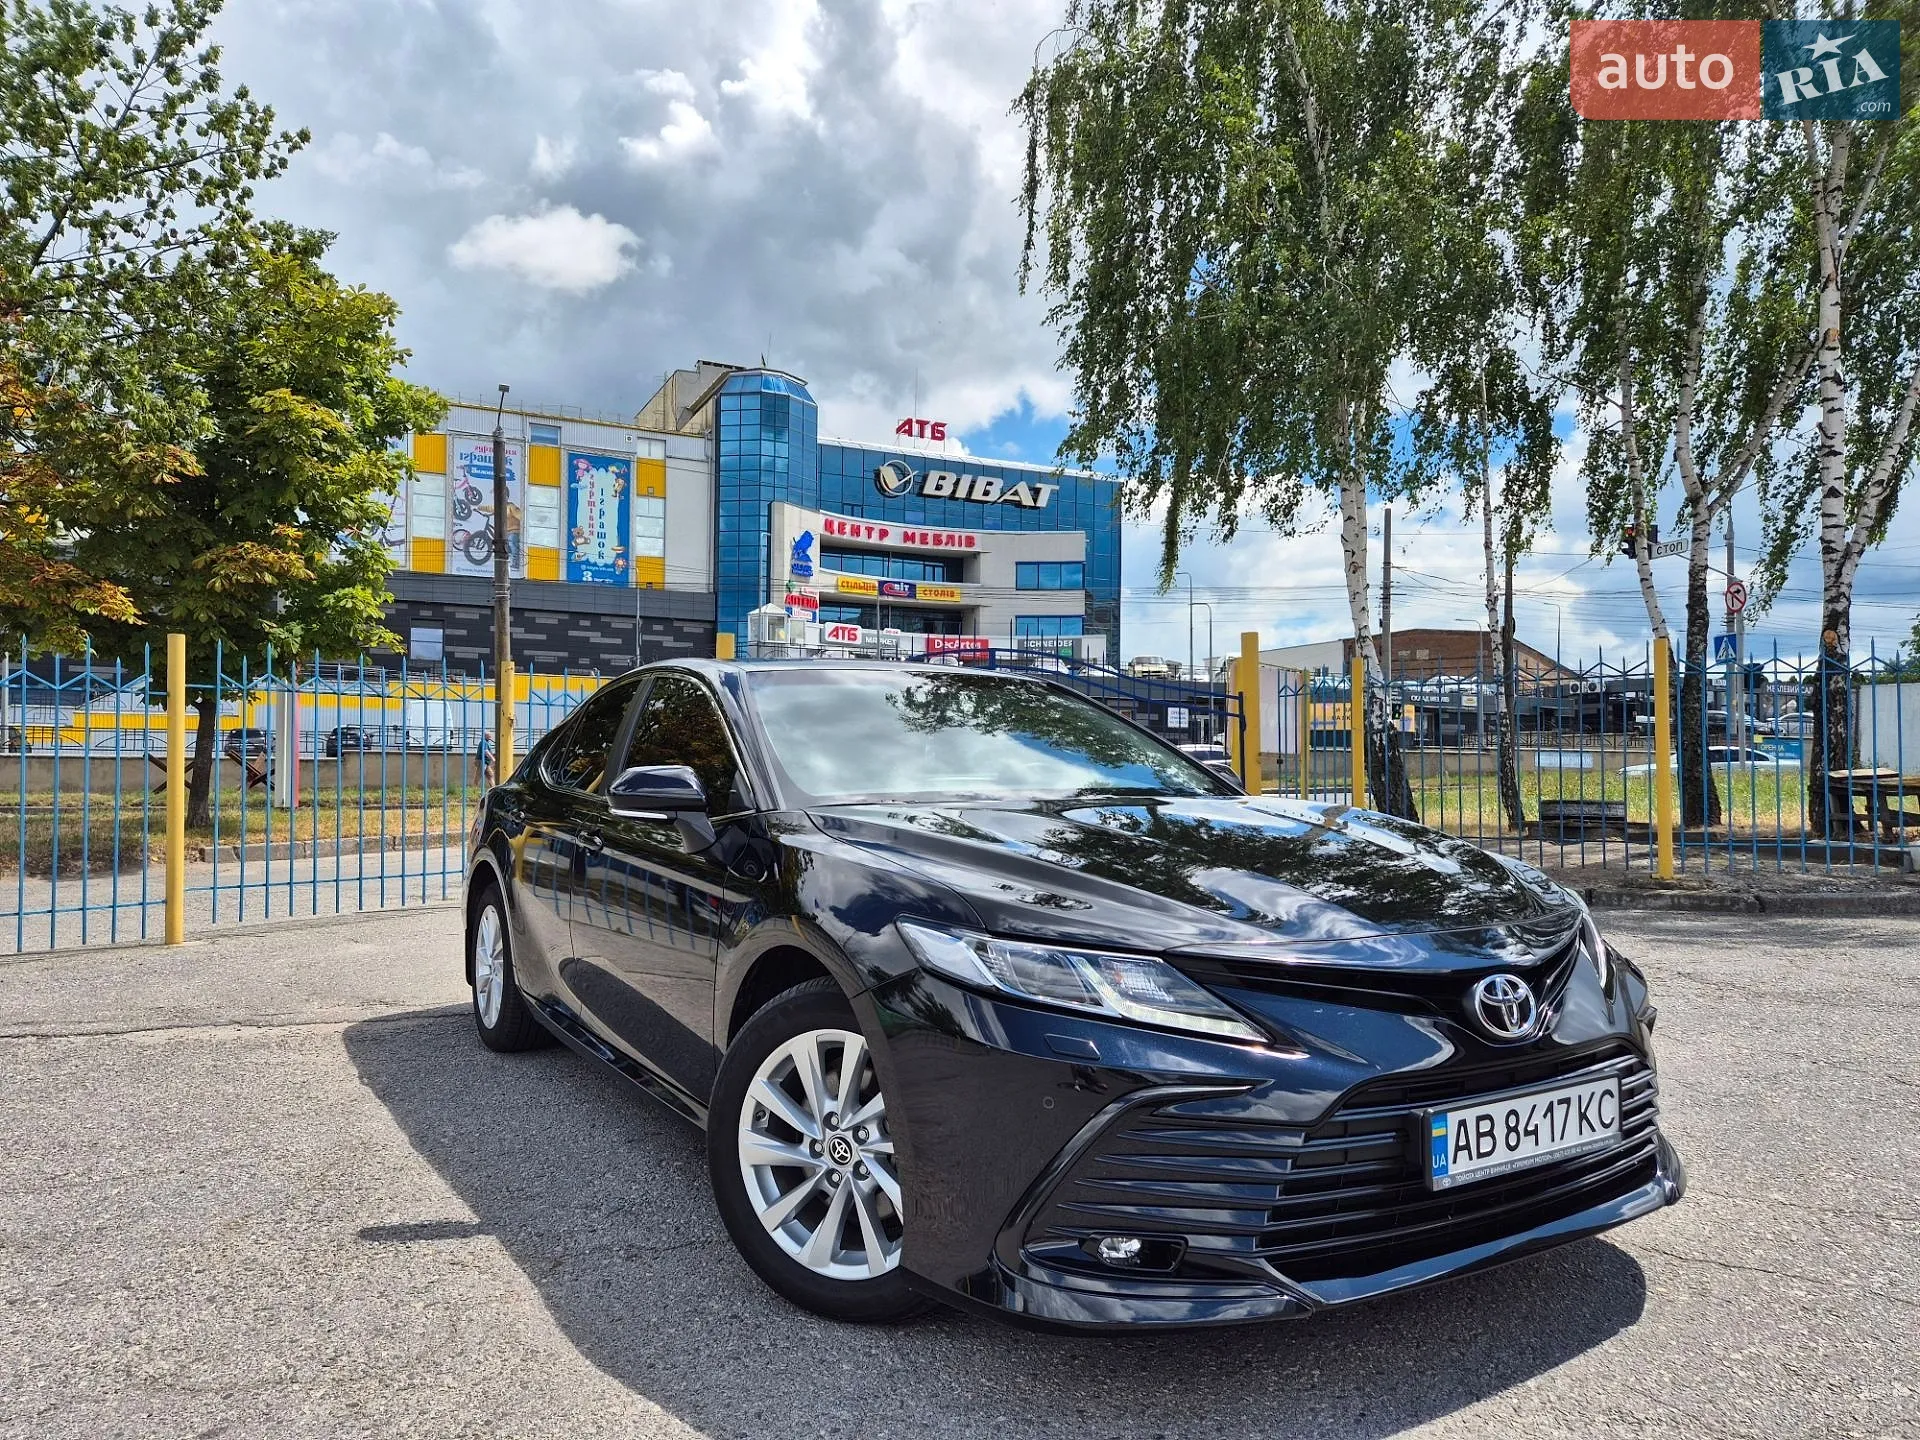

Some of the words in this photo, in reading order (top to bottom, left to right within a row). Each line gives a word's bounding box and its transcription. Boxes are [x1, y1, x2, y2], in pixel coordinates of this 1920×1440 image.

[896, 418, 948, 442] АТБ
[922, 470, 1060, 508] ВІВАТ
[824, 518, 890, 542] ЦЕНТР
[903, 530, 976, 549] МЕБЛІВ
[1656, 541, 1683, 555] СТОП
[922, 588, 956, 599] СТОЛІВ
[828, 625, 859, 642] АТБ
[1452, 1113, 1497, 1165] AB
[1504, 1097, 1572, 1152] 8417
[1577, 1088, 1616, 1136] KC
[1432, 1153, 1447, 1169] UA
